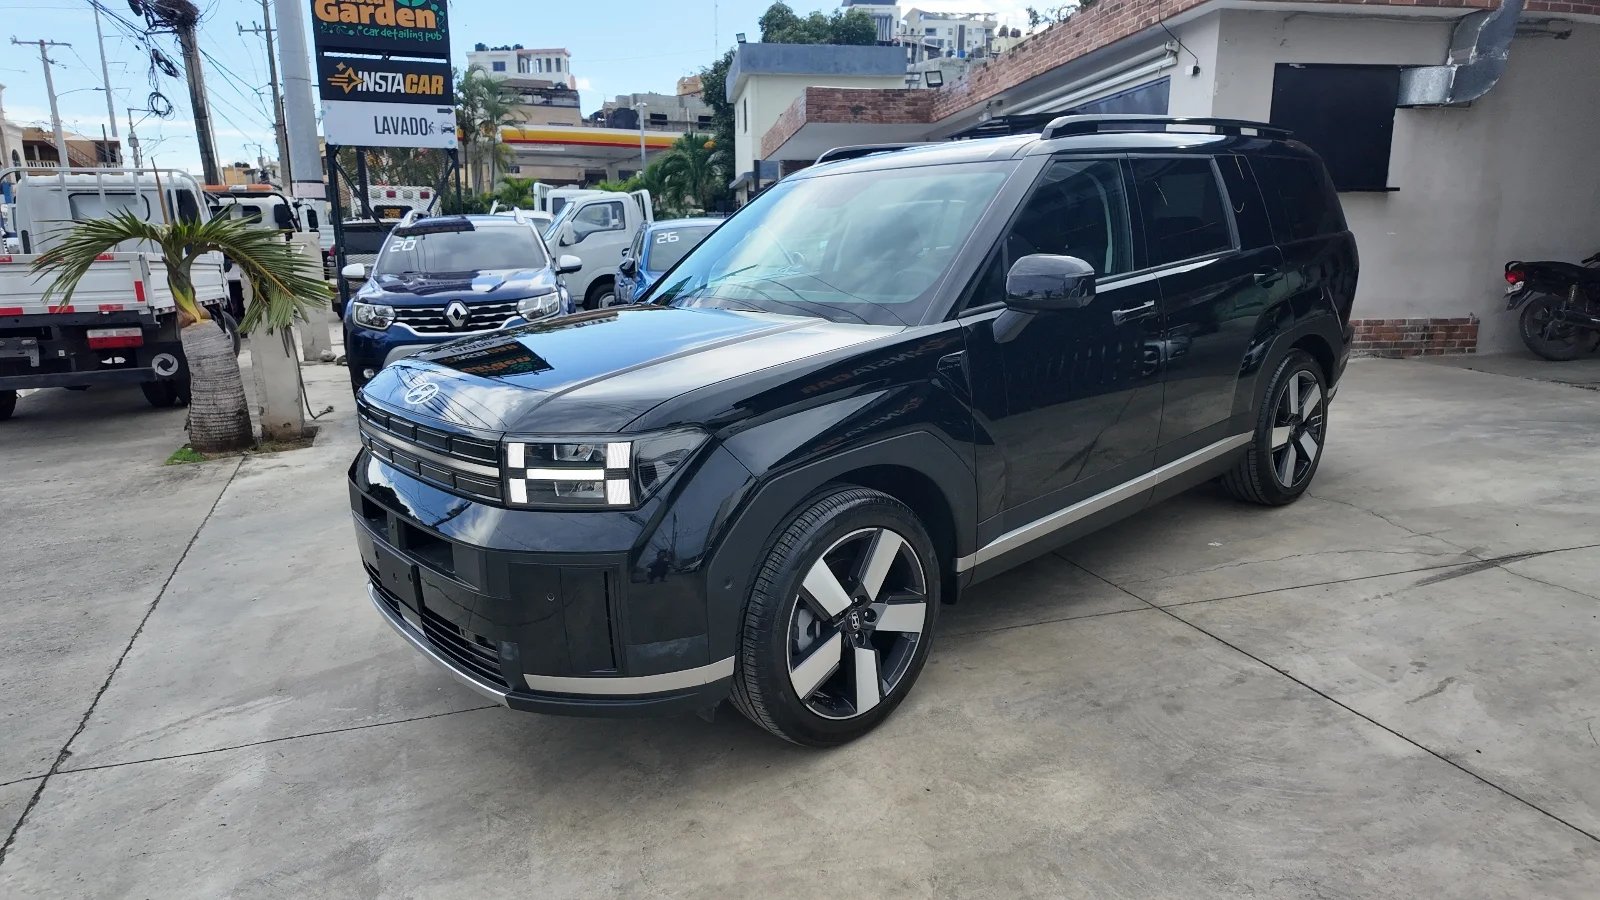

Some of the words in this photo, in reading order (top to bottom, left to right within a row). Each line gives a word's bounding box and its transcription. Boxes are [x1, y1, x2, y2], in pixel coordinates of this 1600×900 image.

[314, 0, 437, 29] Garden
[363, 27, 380, 37] car
[381, 28, 423, 41] detailing
[425, 32, 443, 42] pub
[357, 71, 444, 95] INSTACAR
[374, 116, 428, 136] LAVADO
[390, 239, 417, 252] 20
[656, 231, 680, 244] 26
